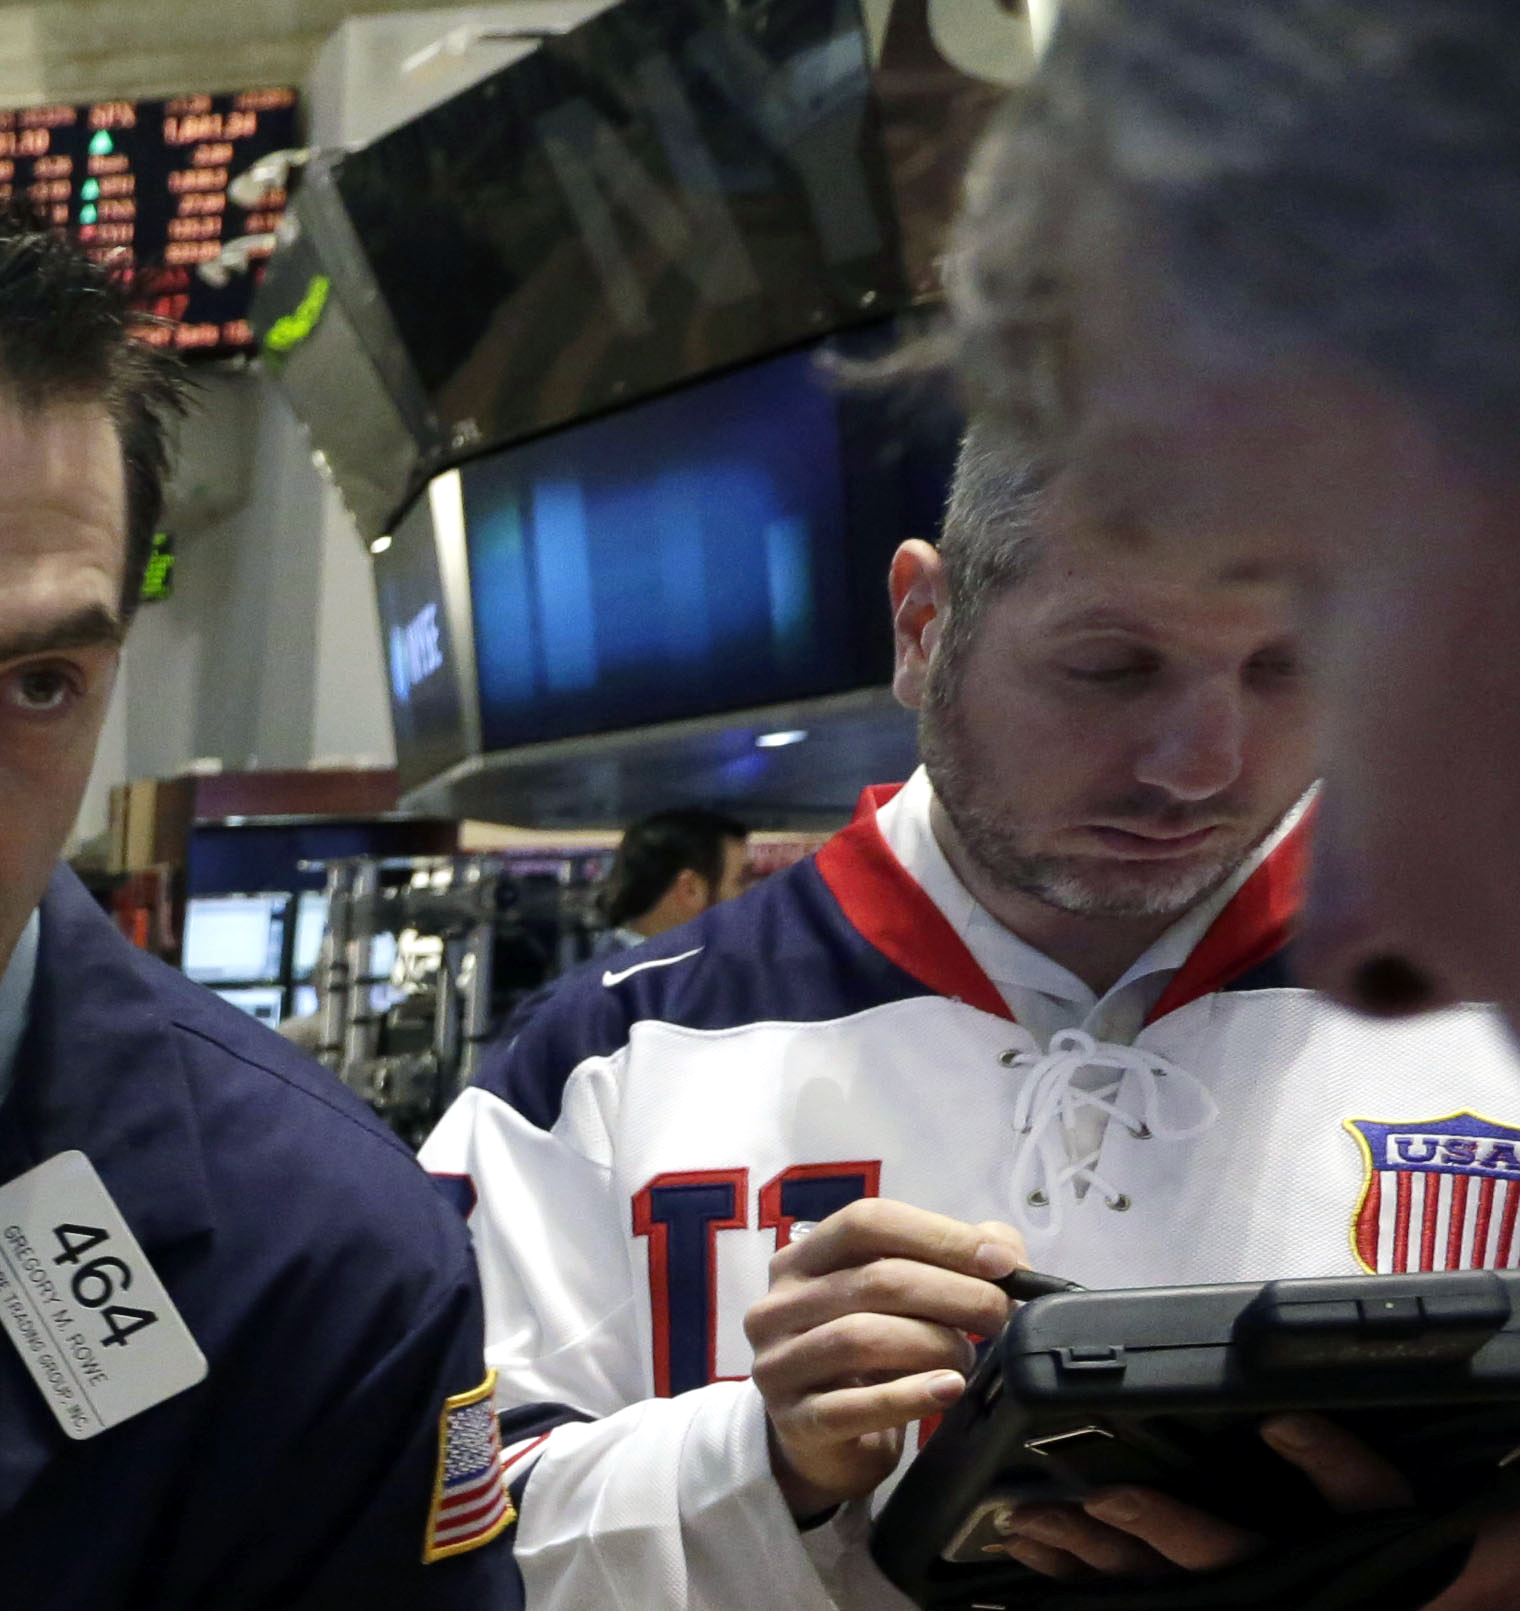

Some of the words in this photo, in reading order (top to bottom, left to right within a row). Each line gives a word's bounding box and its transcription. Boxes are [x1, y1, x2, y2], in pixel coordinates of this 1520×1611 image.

[1394, 1136, 1520, 1171] USA
[3, 1225, 61, 1306] GREGORY
[52, 1308, 73, 1333] M.
[66, 1333, 109, 1387] ROWE
[52, 1223, 159, 1348] 464
